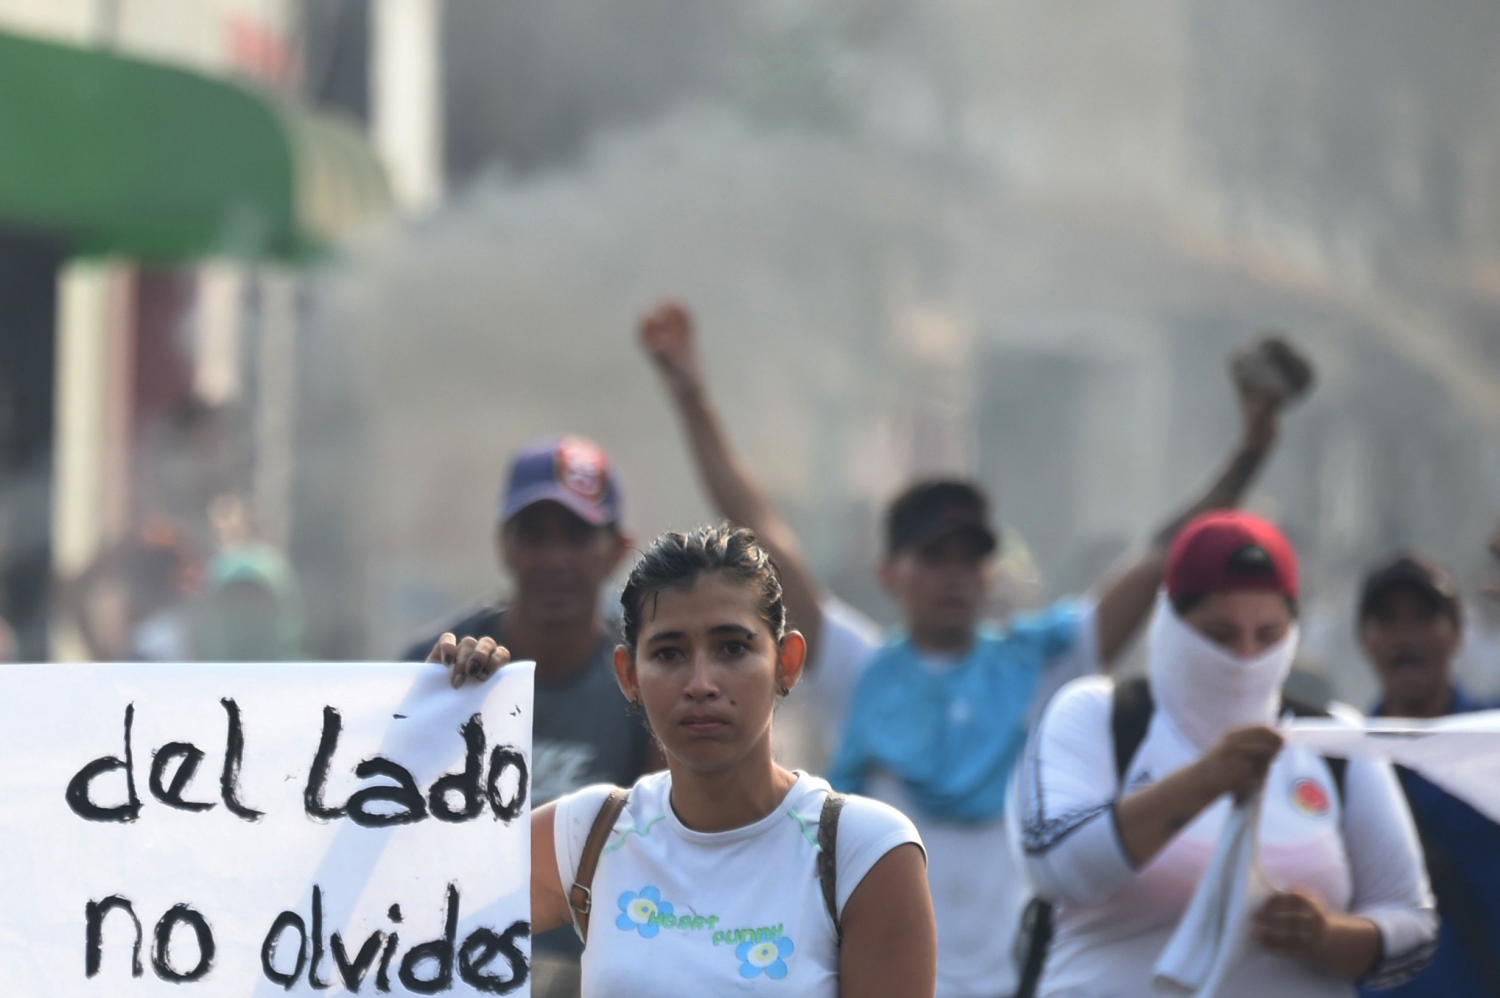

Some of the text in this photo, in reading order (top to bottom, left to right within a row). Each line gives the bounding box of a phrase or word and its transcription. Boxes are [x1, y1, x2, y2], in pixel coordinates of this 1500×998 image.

[65, 697, 265, 823] del
[303, 704, 529, 828] lado
[84, 893, 217, 984] no
[261, 881, 531, 996] olvides
